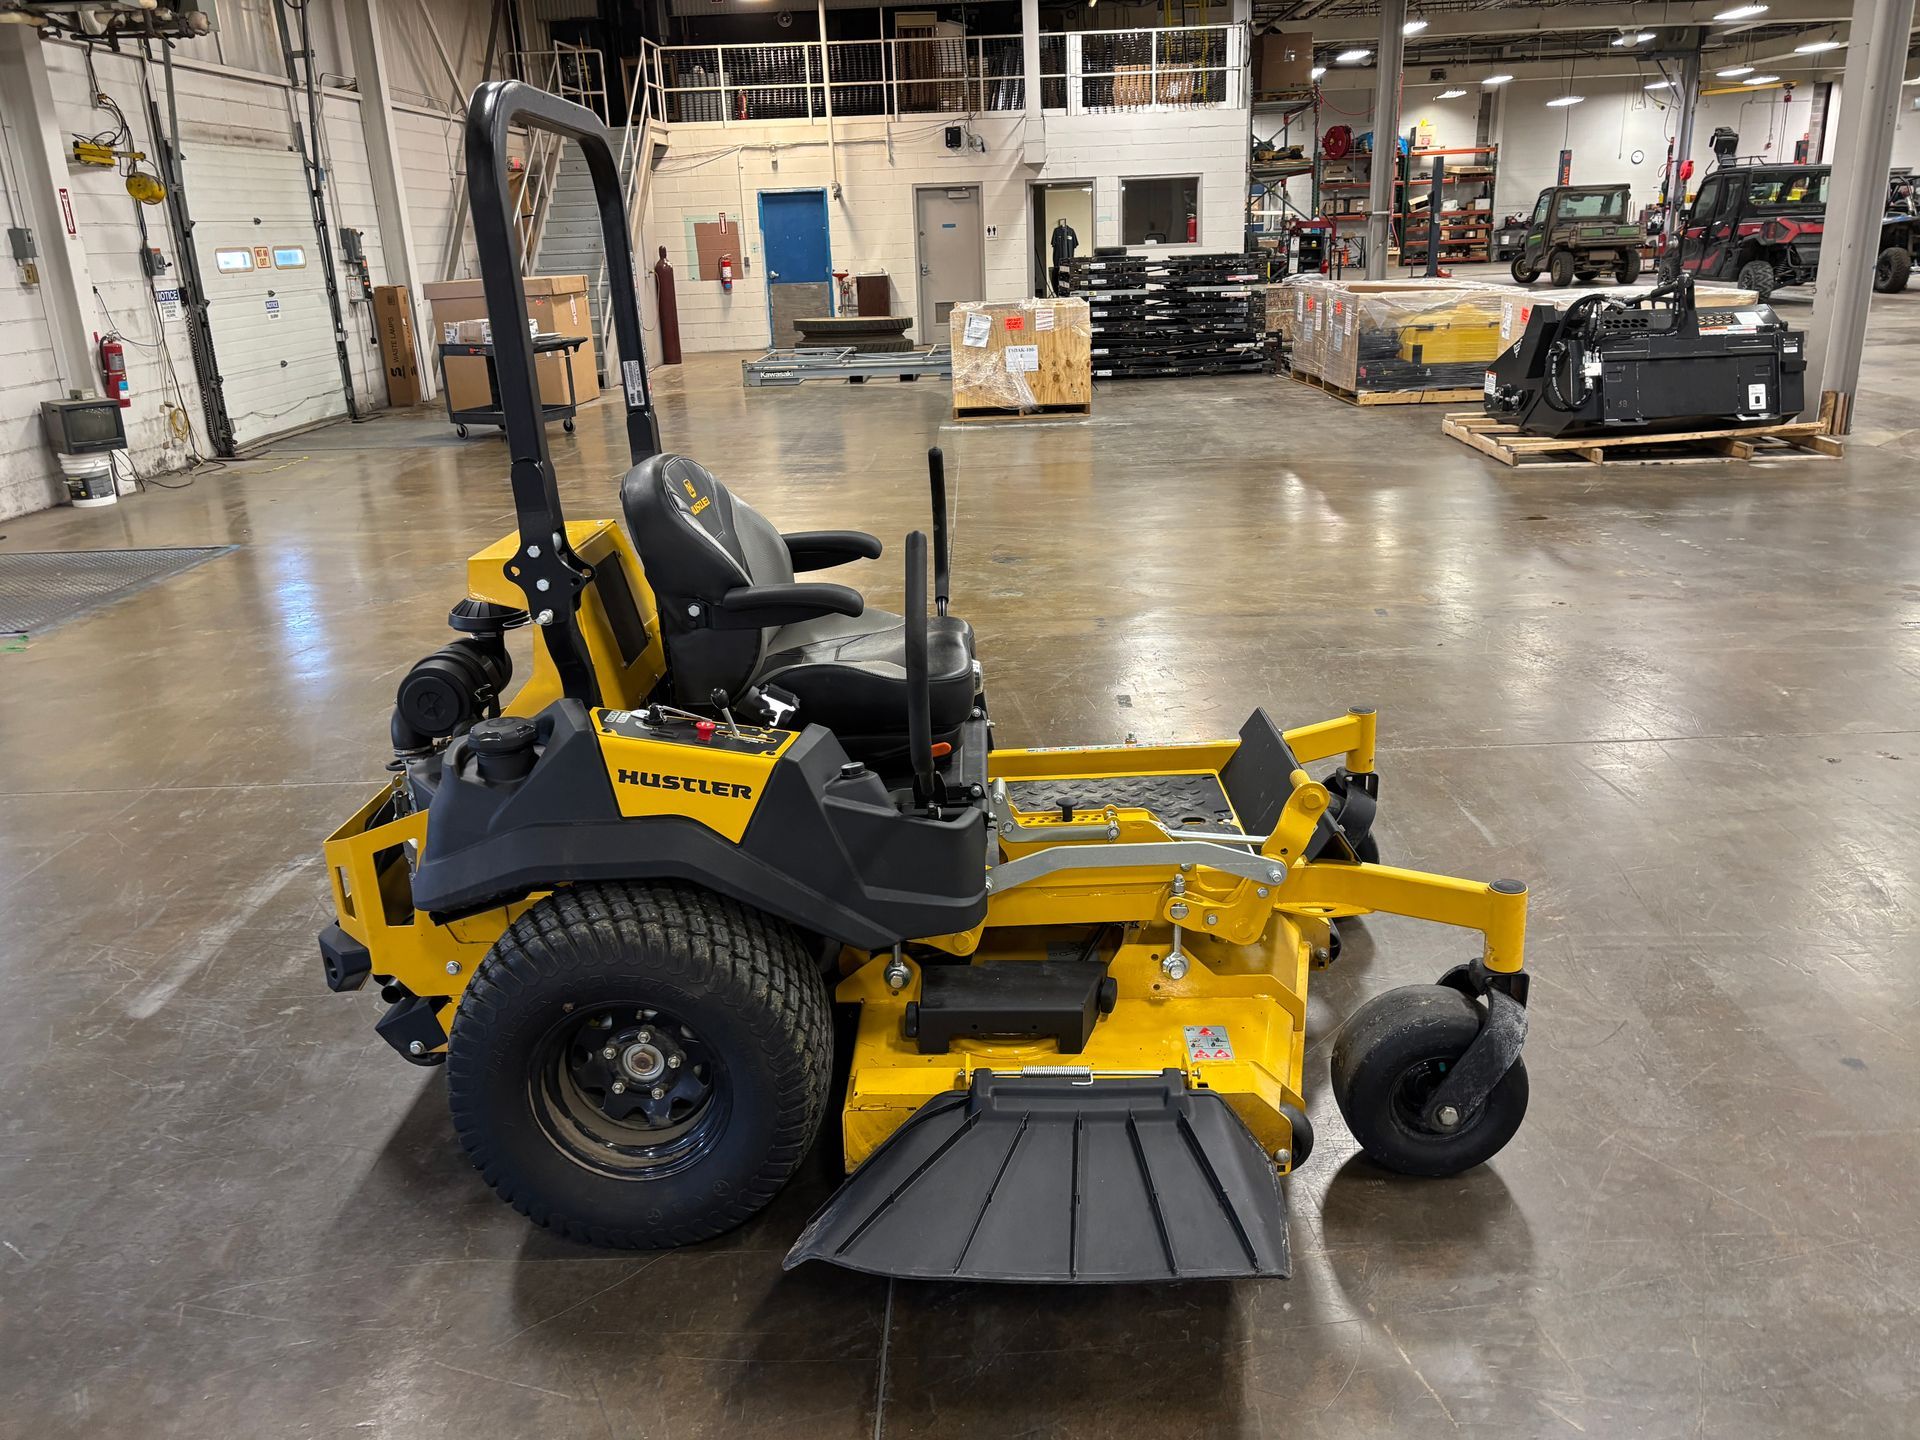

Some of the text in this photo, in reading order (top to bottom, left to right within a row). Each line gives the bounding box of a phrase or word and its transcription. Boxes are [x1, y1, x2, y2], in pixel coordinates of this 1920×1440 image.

[155, 290, 179, 301] NOTICE
[390, 341, 399, 363] WASTE
[617, 768, 752, 800] HUSTLER
